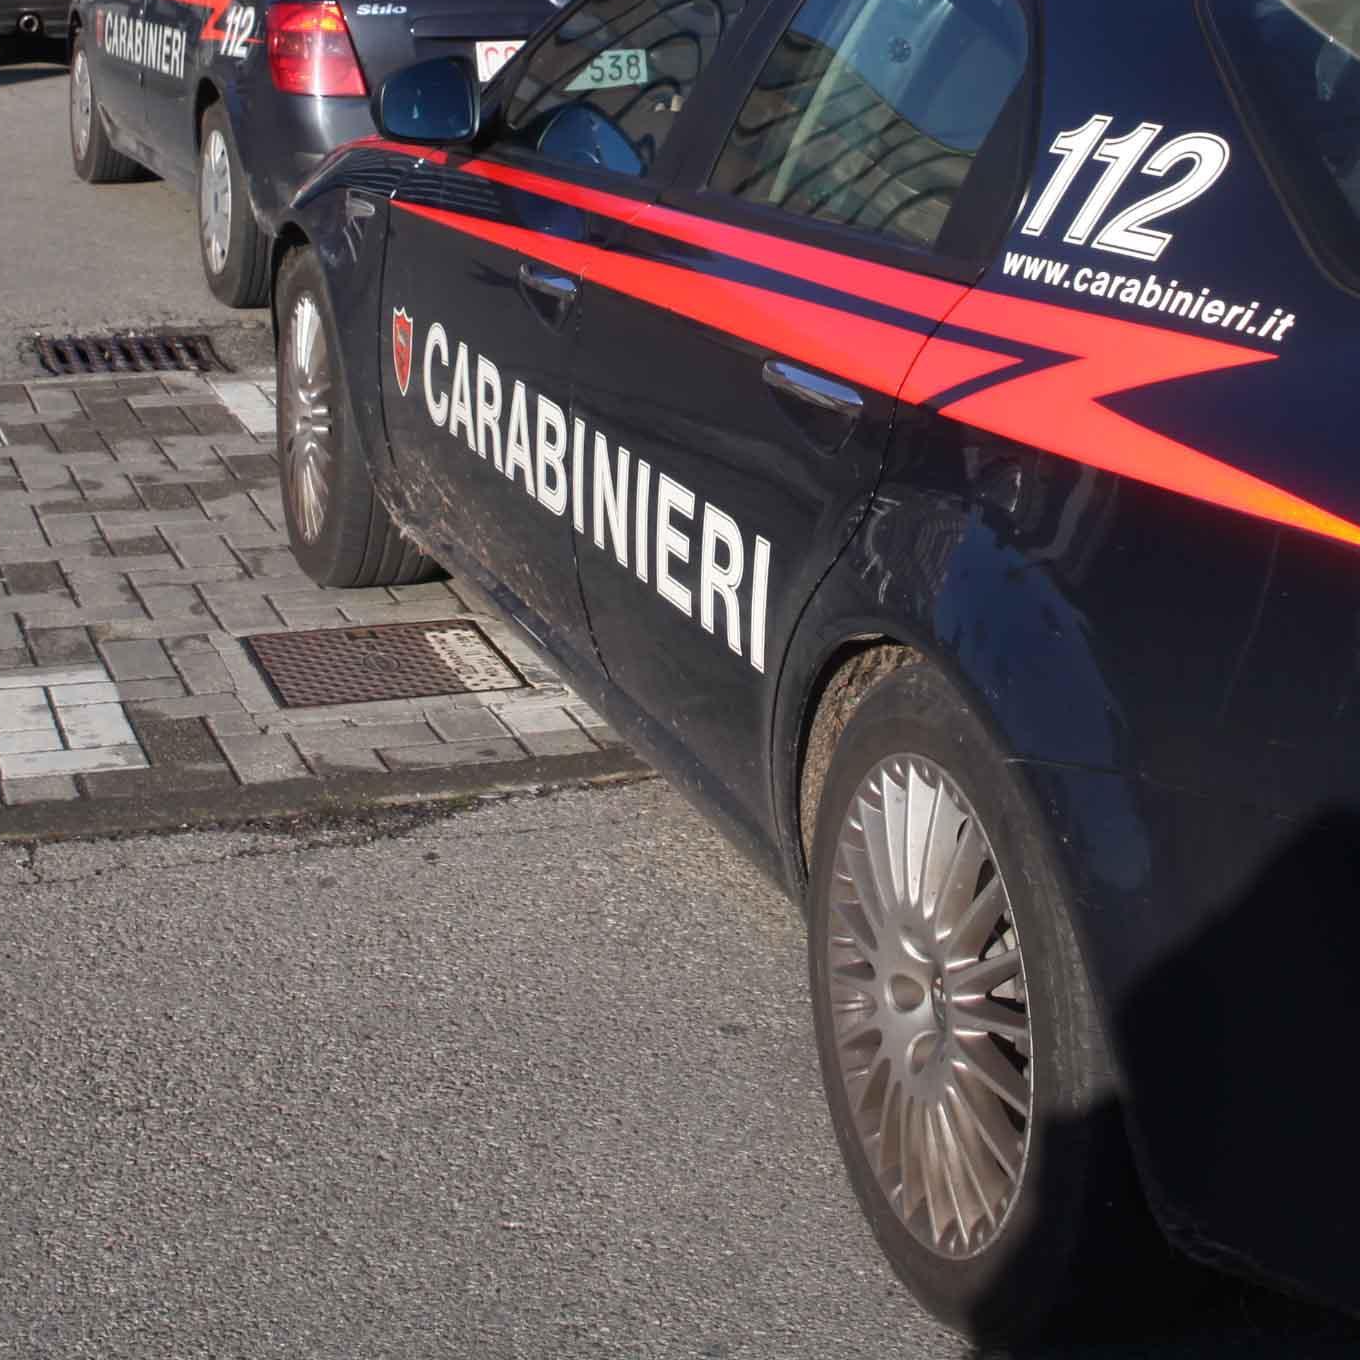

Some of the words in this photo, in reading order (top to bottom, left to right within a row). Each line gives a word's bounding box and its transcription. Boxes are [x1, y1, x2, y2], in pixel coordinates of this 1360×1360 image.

[104, 11, 187, 80] CARABINIERI
[219, 5, 256, 59] 112
[356, 3, 408, 16] Stilo
[1021, 114, 1231, 262] 112
[1002, 251, 1296, 342] www.carabinieri.it
[422, 321, 772, 674] CARABINIERI
